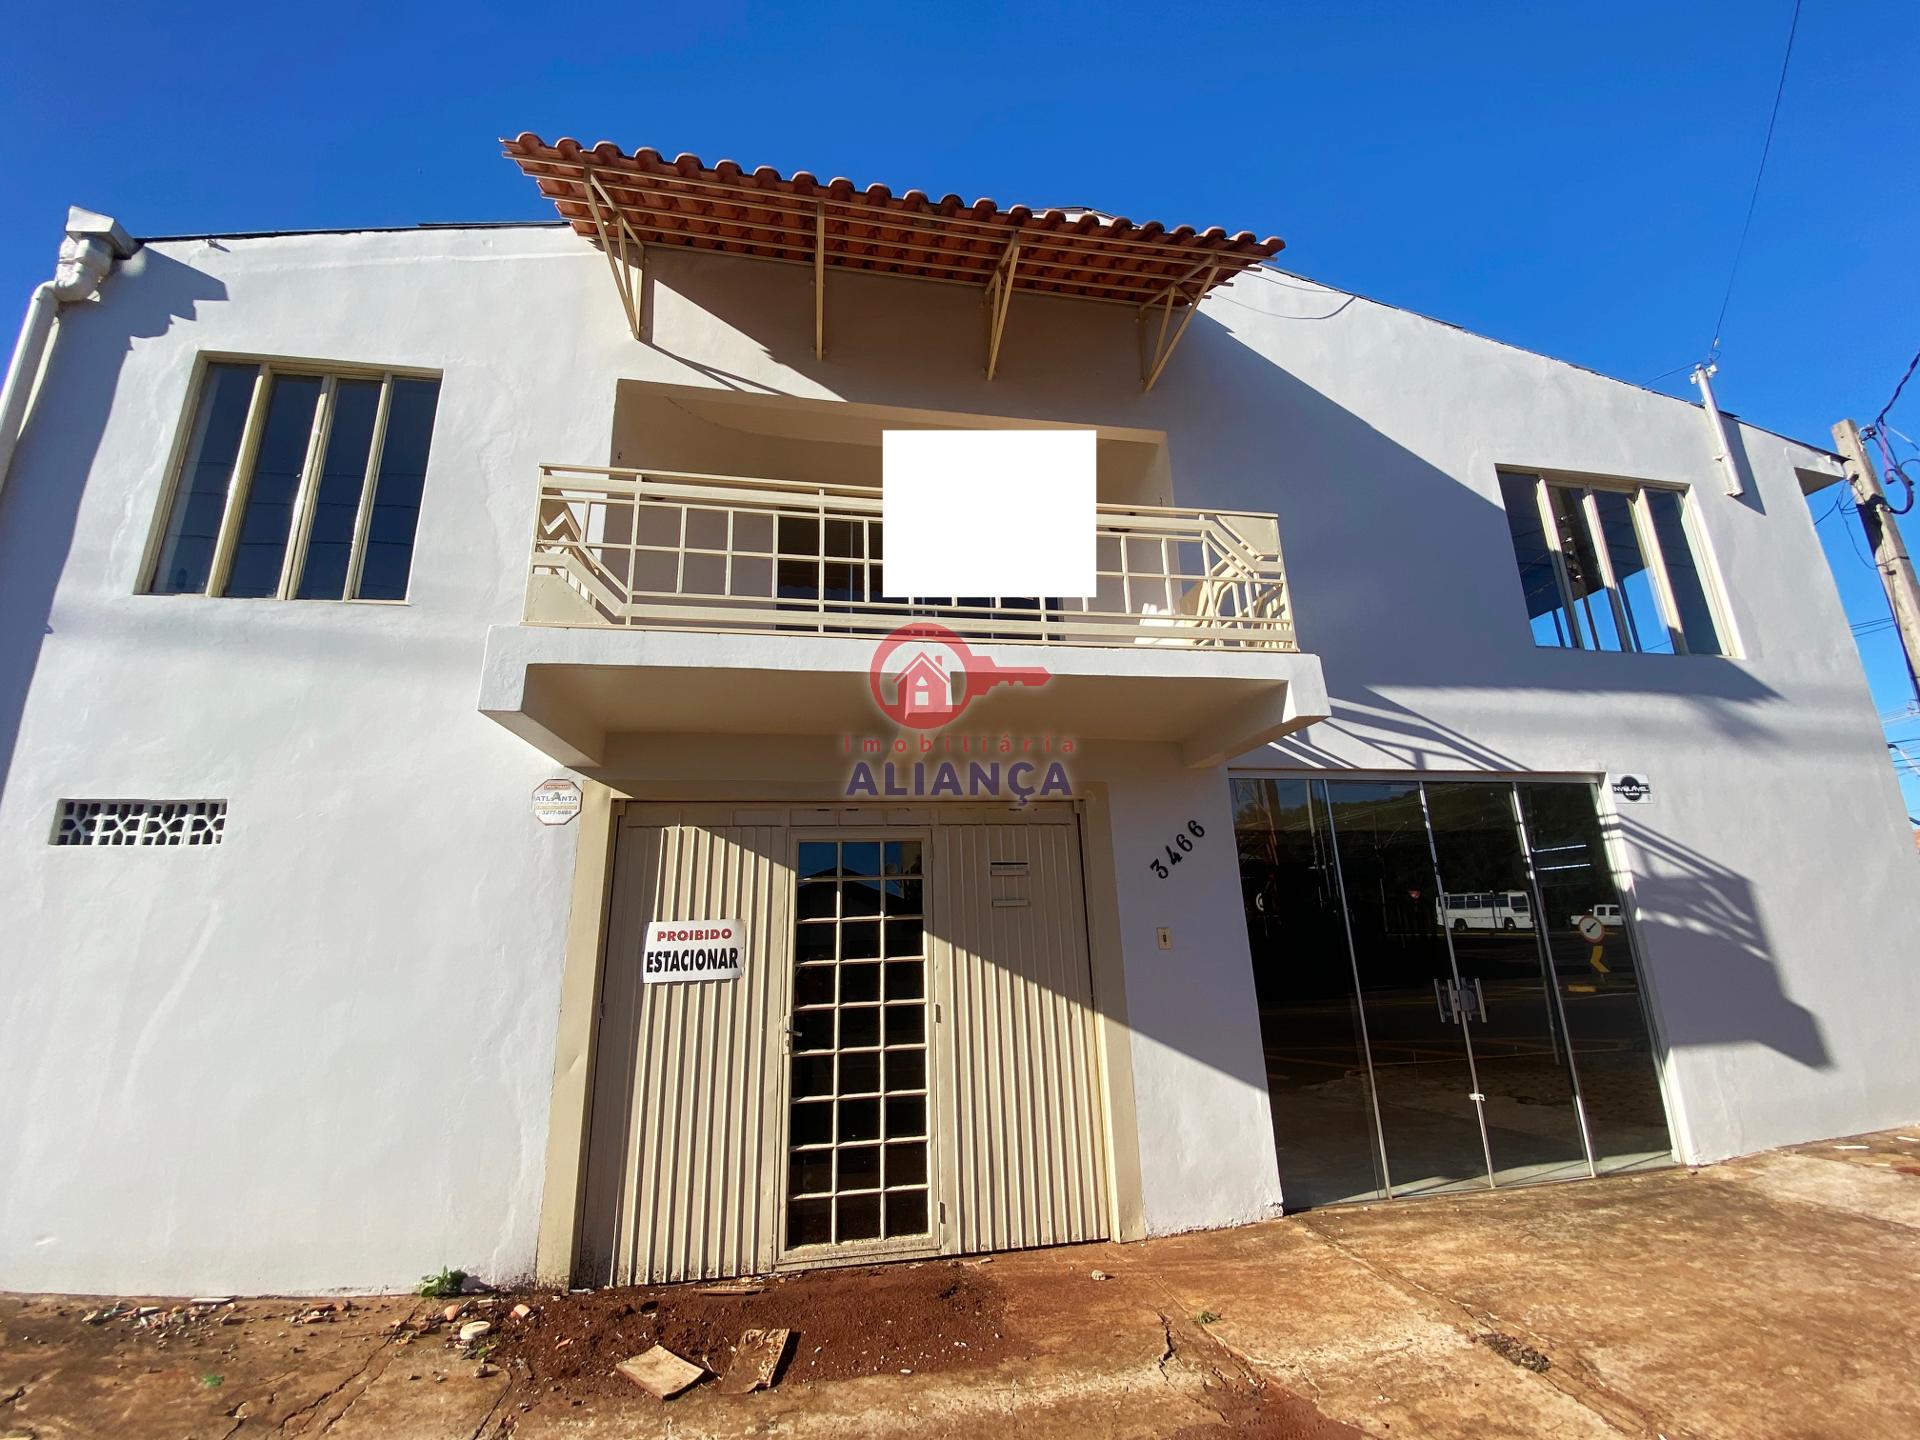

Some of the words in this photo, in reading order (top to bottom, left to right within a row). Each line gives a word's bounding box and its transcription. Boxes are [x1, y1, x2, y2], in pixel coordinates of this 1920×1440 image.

[535, 792, 578, 801] ATLANTA
[1149, 819, 1206, 880] 3466
[656, 928, 733, 942] PROIBIDO
[646, 947, 739, 973] ESTACIONAR
